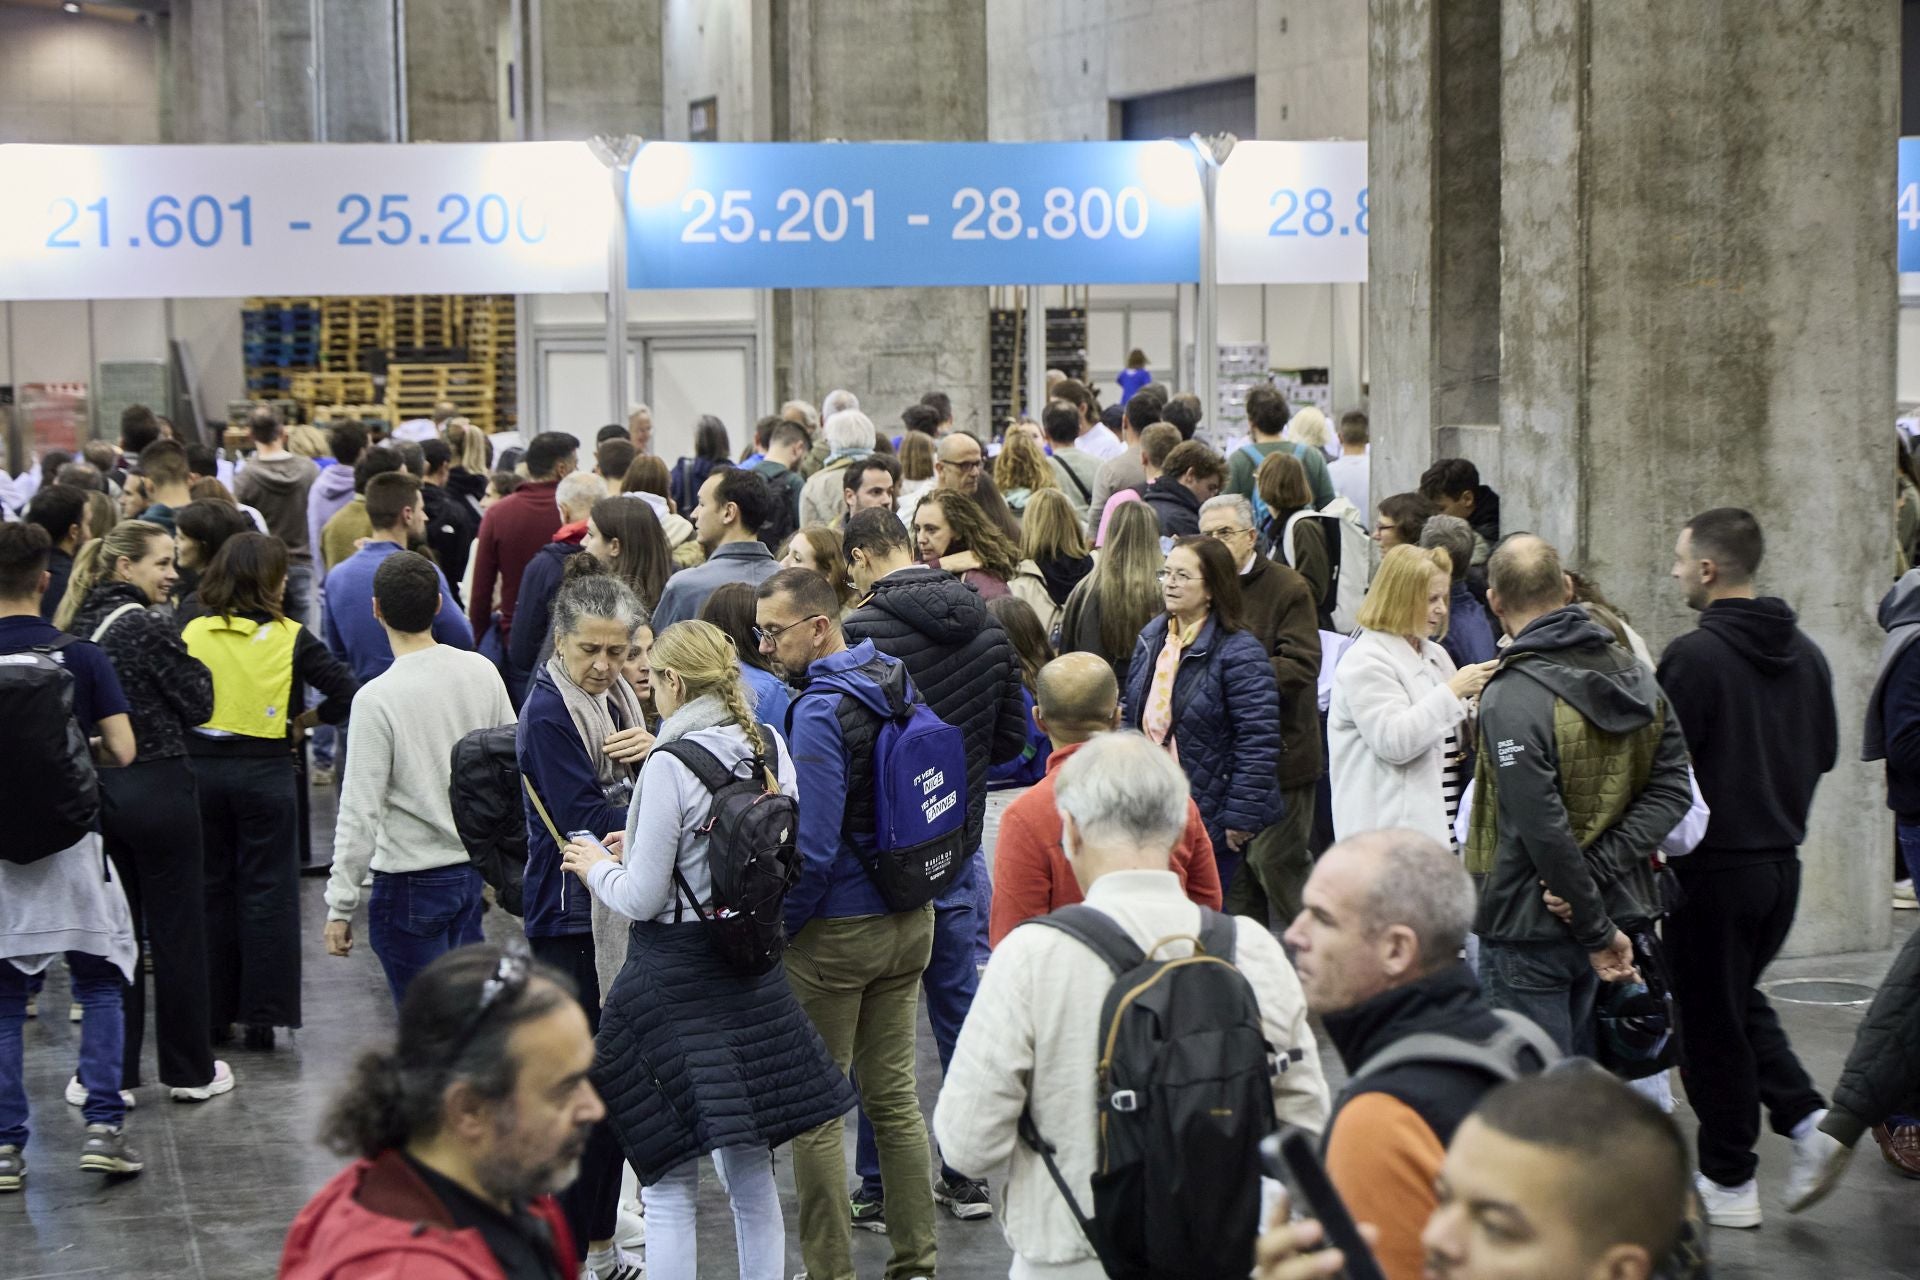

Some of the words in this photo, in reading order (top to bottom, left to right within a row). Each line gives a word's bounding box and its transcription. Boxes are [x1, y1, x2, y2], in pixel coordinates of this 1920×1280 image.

[45, 194, 253, 248] 21.601
[289, 221, 312, 231] -
[337, 193, 548, 246] 25.200
[680, 188, 875, 243] 25.201
[907, 214, 930, 226] -
[951, 187, 1149, 240] 28.800
[922, 767, 935, 779] VERY
[924, 772, 943, 793] NICE
[921, 800, 930, 811] YES
[927, 792, 956, 822] CANNES
